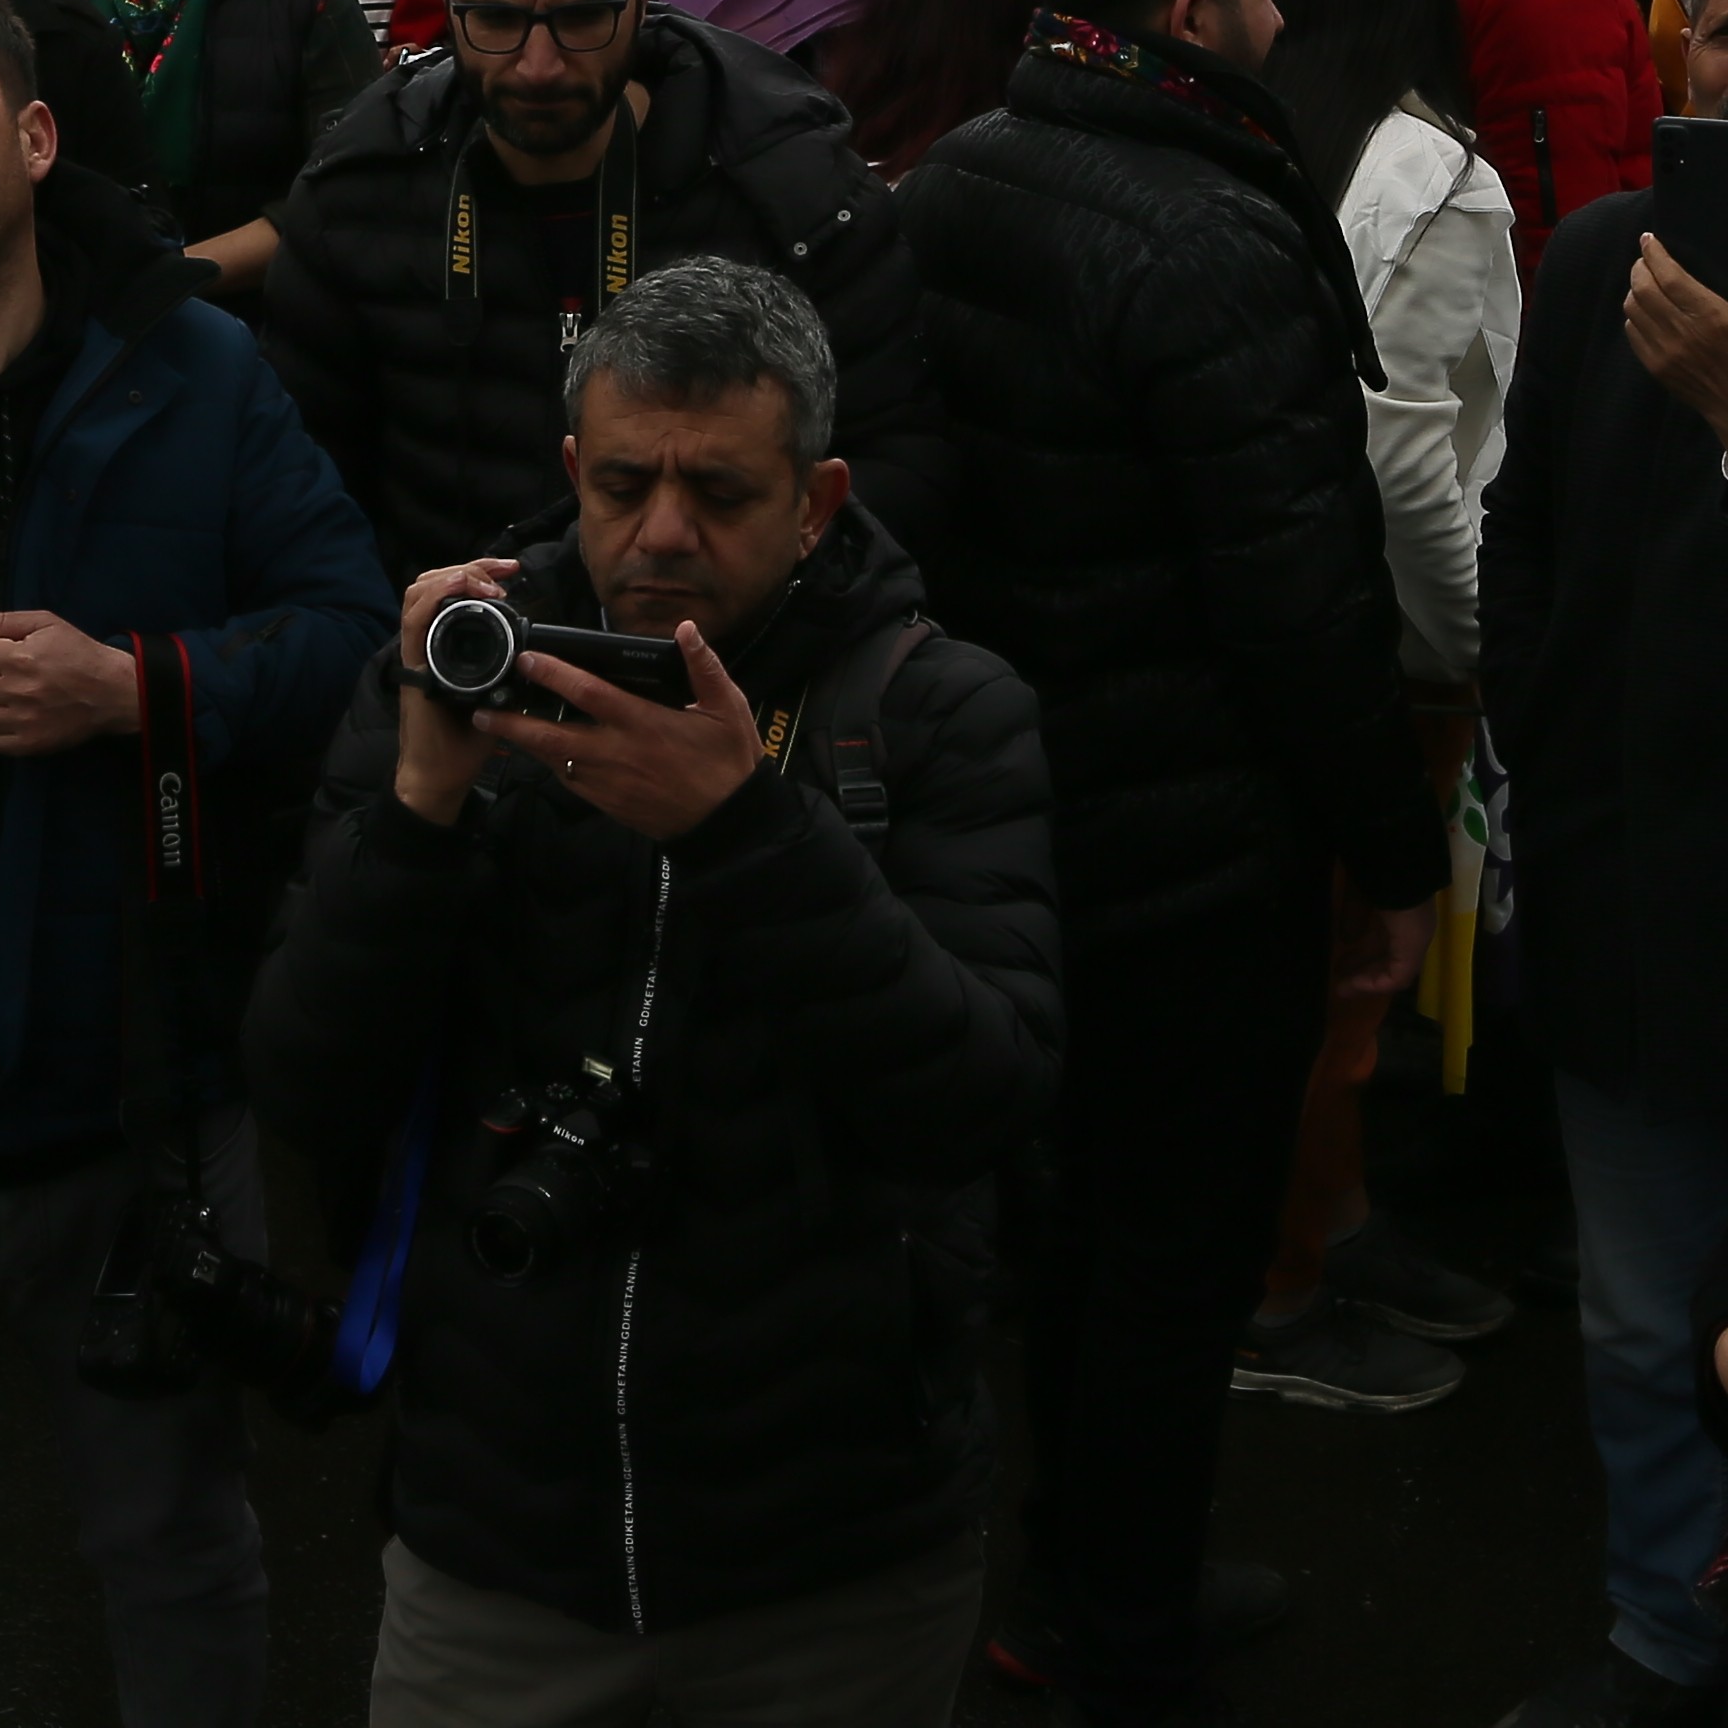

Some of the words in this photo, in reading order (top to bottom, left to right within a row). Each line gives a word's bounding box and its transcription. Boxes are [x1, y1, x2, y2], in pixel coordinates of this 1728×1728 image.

[452, 193, 471, 275] Nikon
[605, 213, 630, 295] Nikon
[159, 771, 182, 868] Canon
[553, 1124, 585, 1147] Nikon
